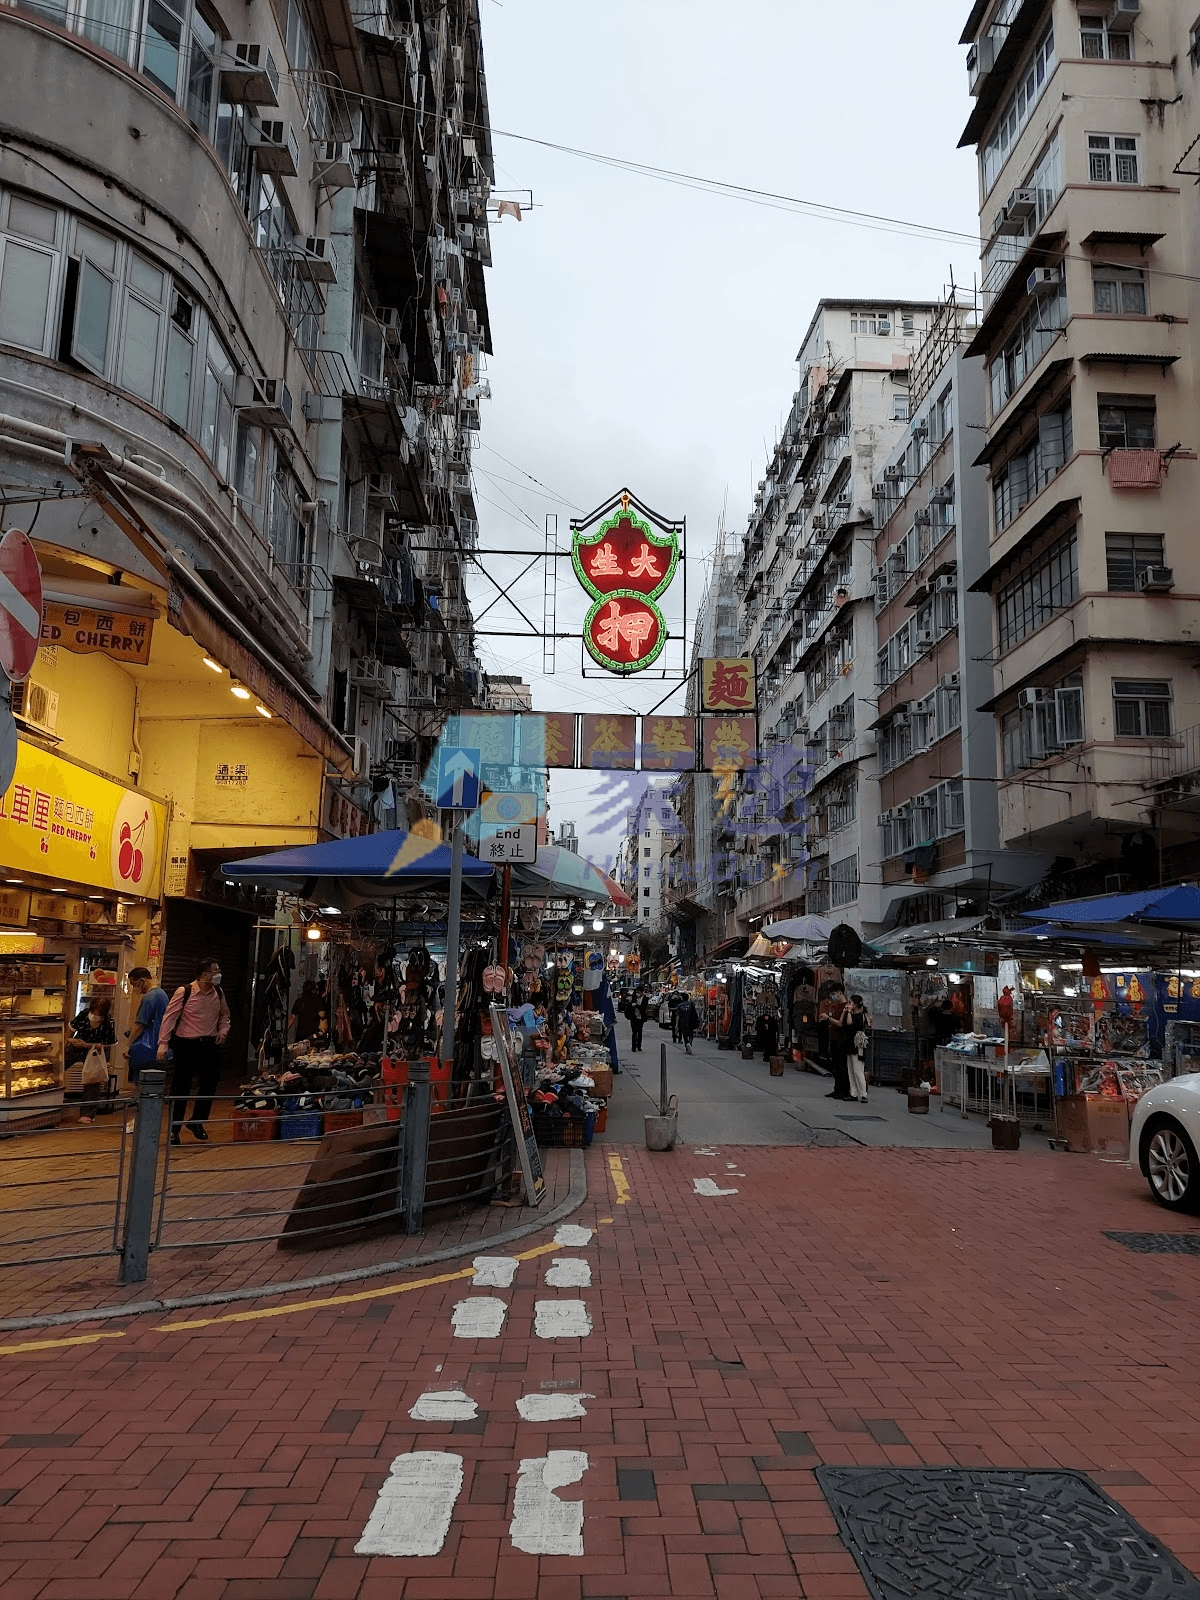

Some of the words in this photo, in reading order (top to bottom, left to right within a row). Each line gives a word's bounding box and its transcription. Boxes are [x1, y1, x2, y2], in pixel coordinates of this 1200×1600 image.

[41, 624, 61, 639] ED
[75, 630, 144, 653] CHERRY
[597, 601, 654, 659] 押
[706, 661, 752, 707] 麵
[54, 796, 94, 831] 麵包西餅
[52, 823, 65, 836] RED
[66, 828, 92, 844] CHERRY
[496, 829, 520, 839] End
[490, 843, 524, 858] 終止
